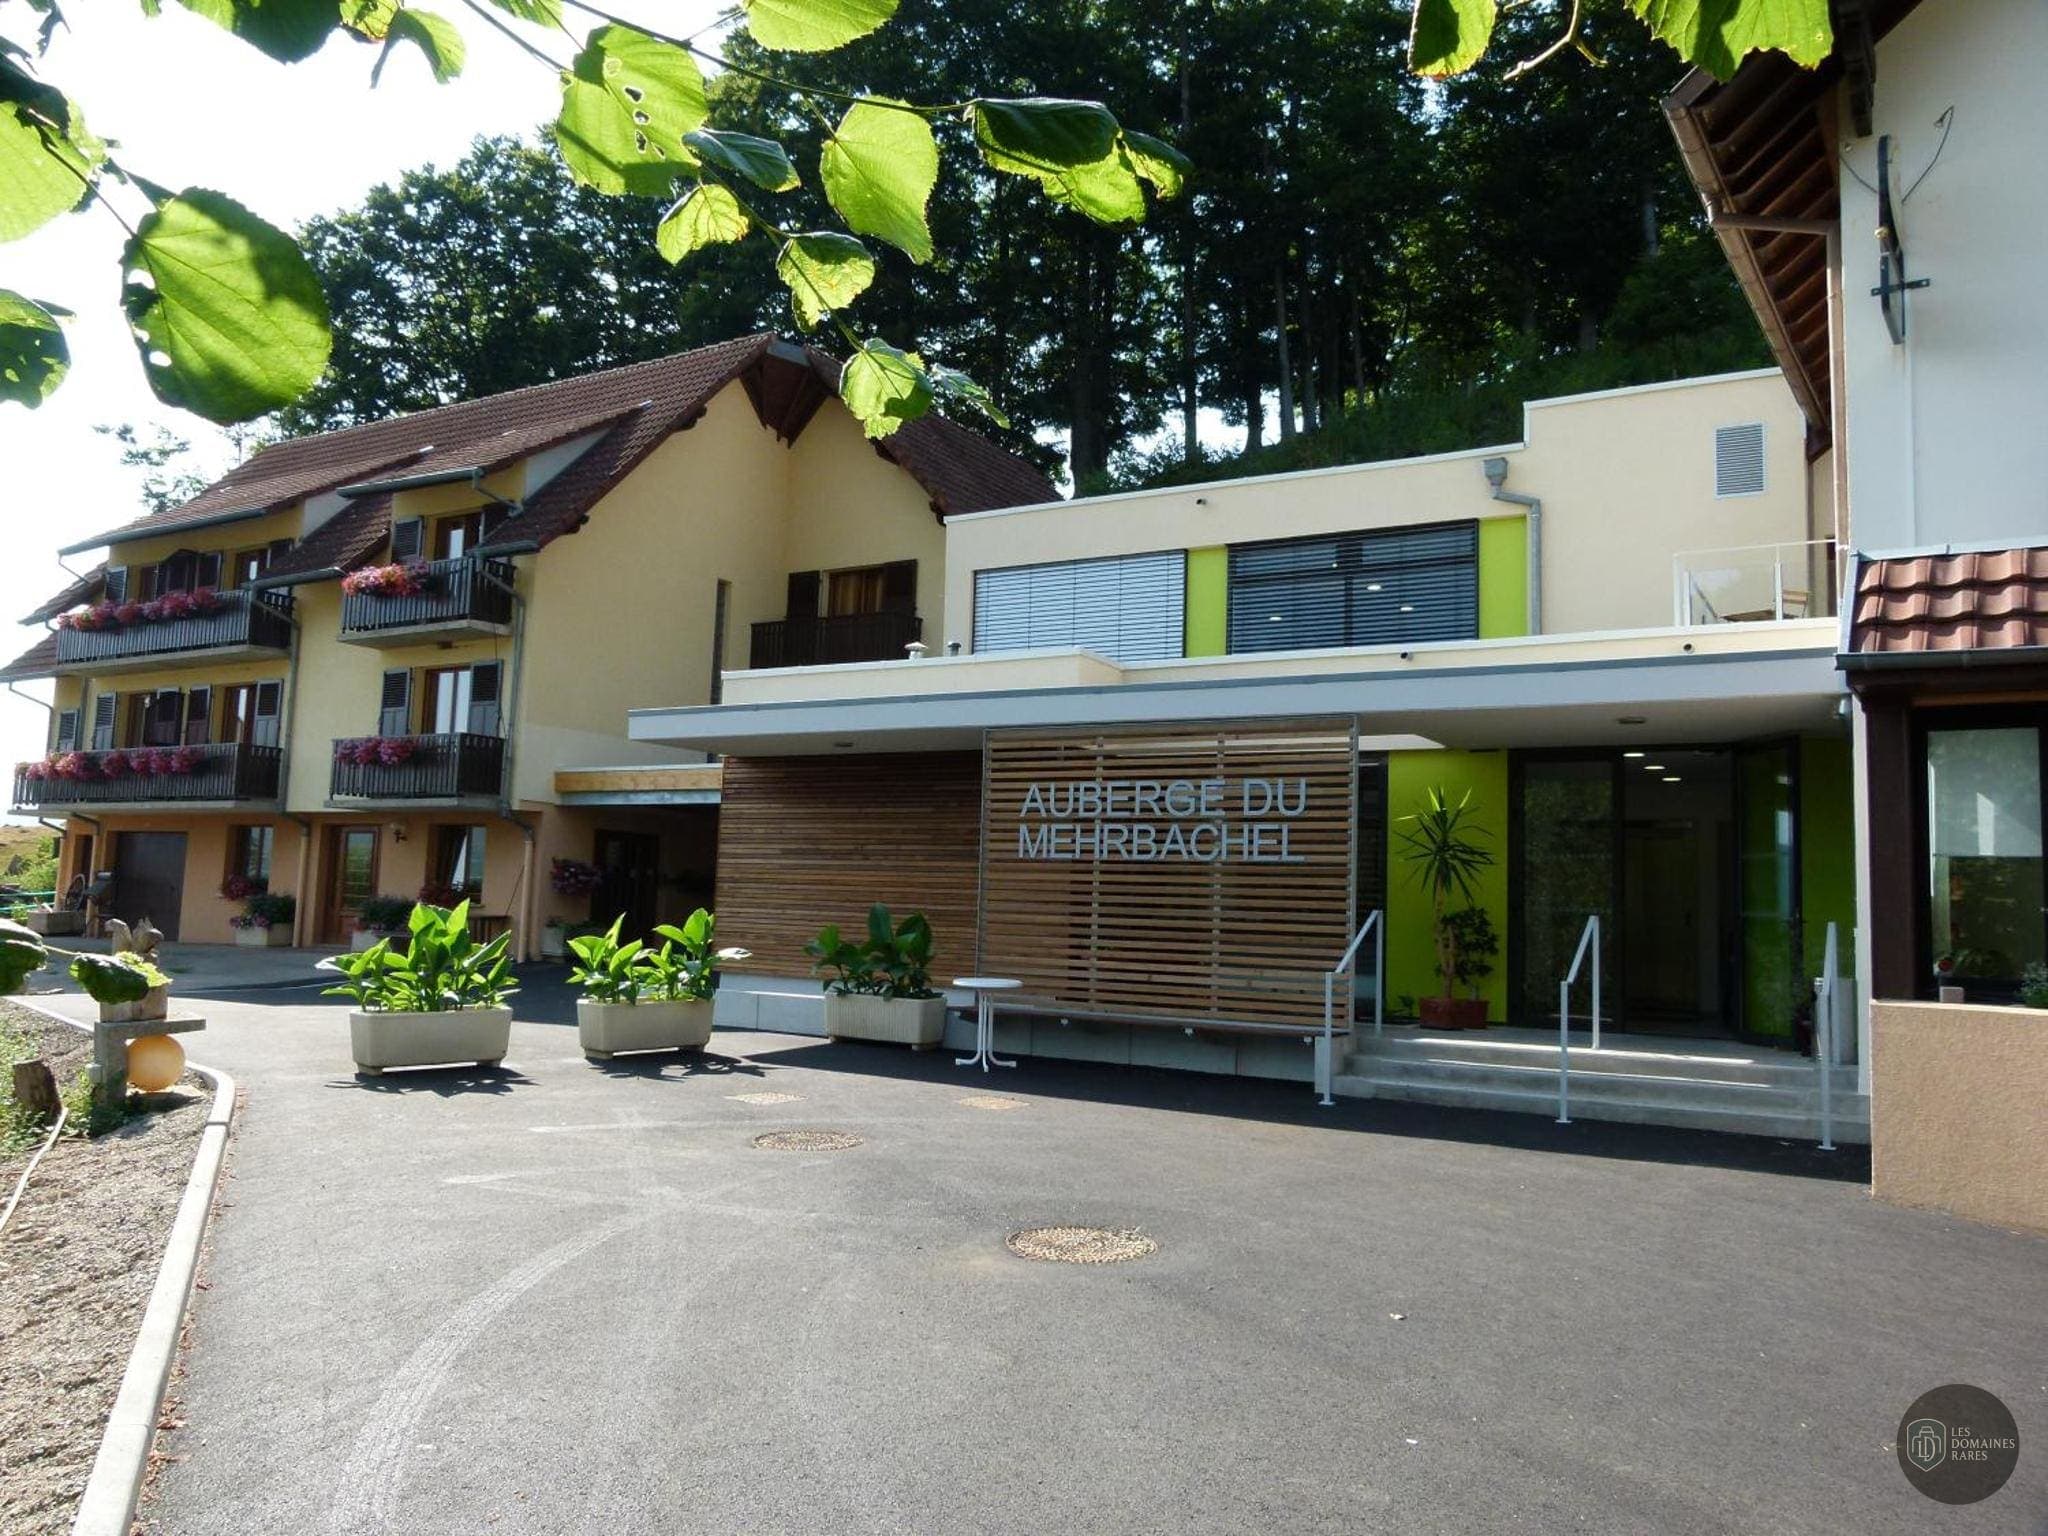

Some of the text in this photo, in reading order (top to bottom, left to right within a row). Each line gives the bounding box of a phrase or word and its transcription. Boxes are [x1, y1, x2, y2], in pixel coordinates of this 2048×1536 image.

[1019, 778, 1307, 818] AUBERGE DU
[1018, 823, 1305, 862] MEHRBACHEL
